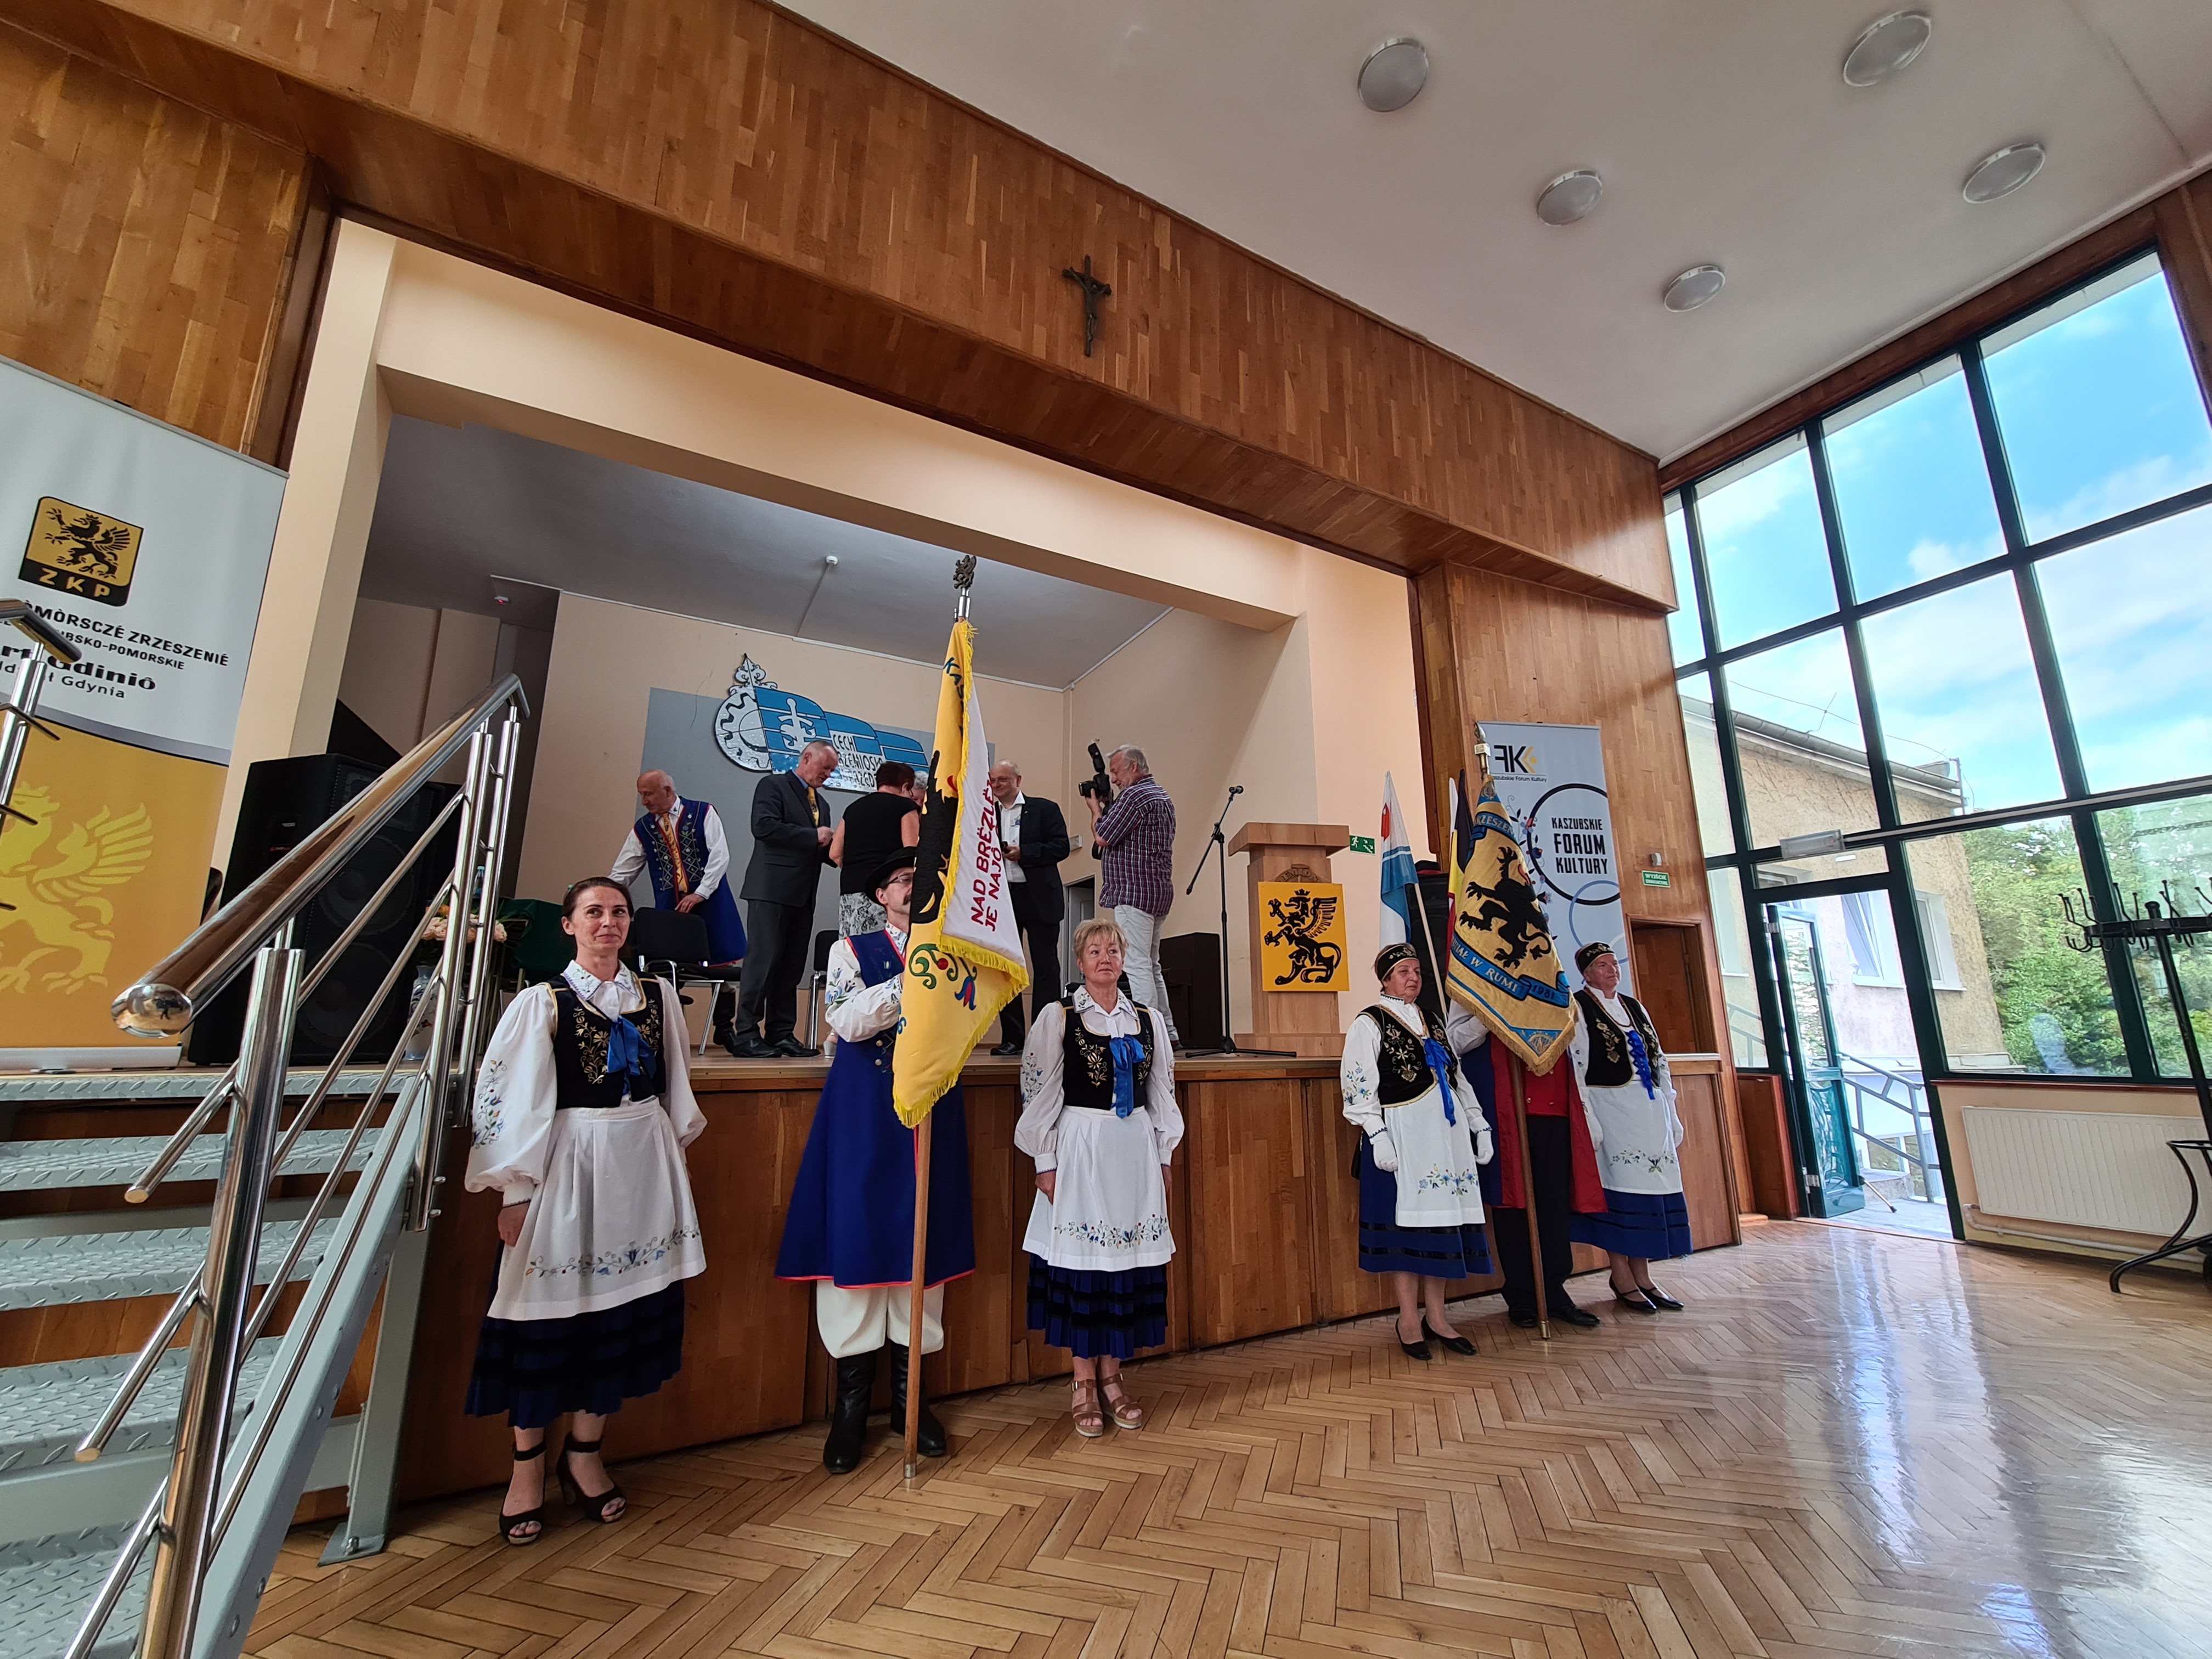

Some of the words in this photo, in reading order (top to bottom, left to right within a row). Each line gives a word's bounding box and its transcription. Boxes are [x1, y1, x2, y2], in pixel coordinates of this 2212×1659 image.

[40, 567, 110, 597] ZKP
[25, 600, 126, 639] MÒRSCZÉ
[127, 630, 229, 666] ZRZESZENIÉ
[61, 631, 185, 670] BSKO-POMORSKIE
[61, 676, 125, 698] Gdynia
[833, 734, 856, 752] CECH
[1551, 817, 1603, 830] KASZUBSKIE
[1554, 833, 1606, 855] FORUM
[1555, 857, 1607, 874] KULTURY
[971, 879, 986, 925] NAD
[985, 906, 998, 932] JE
[1470, 956, 1483, 968] W
[1485, 967, 1519, 992] RUMI
[1532, 984, 1556, 1000] 1981
